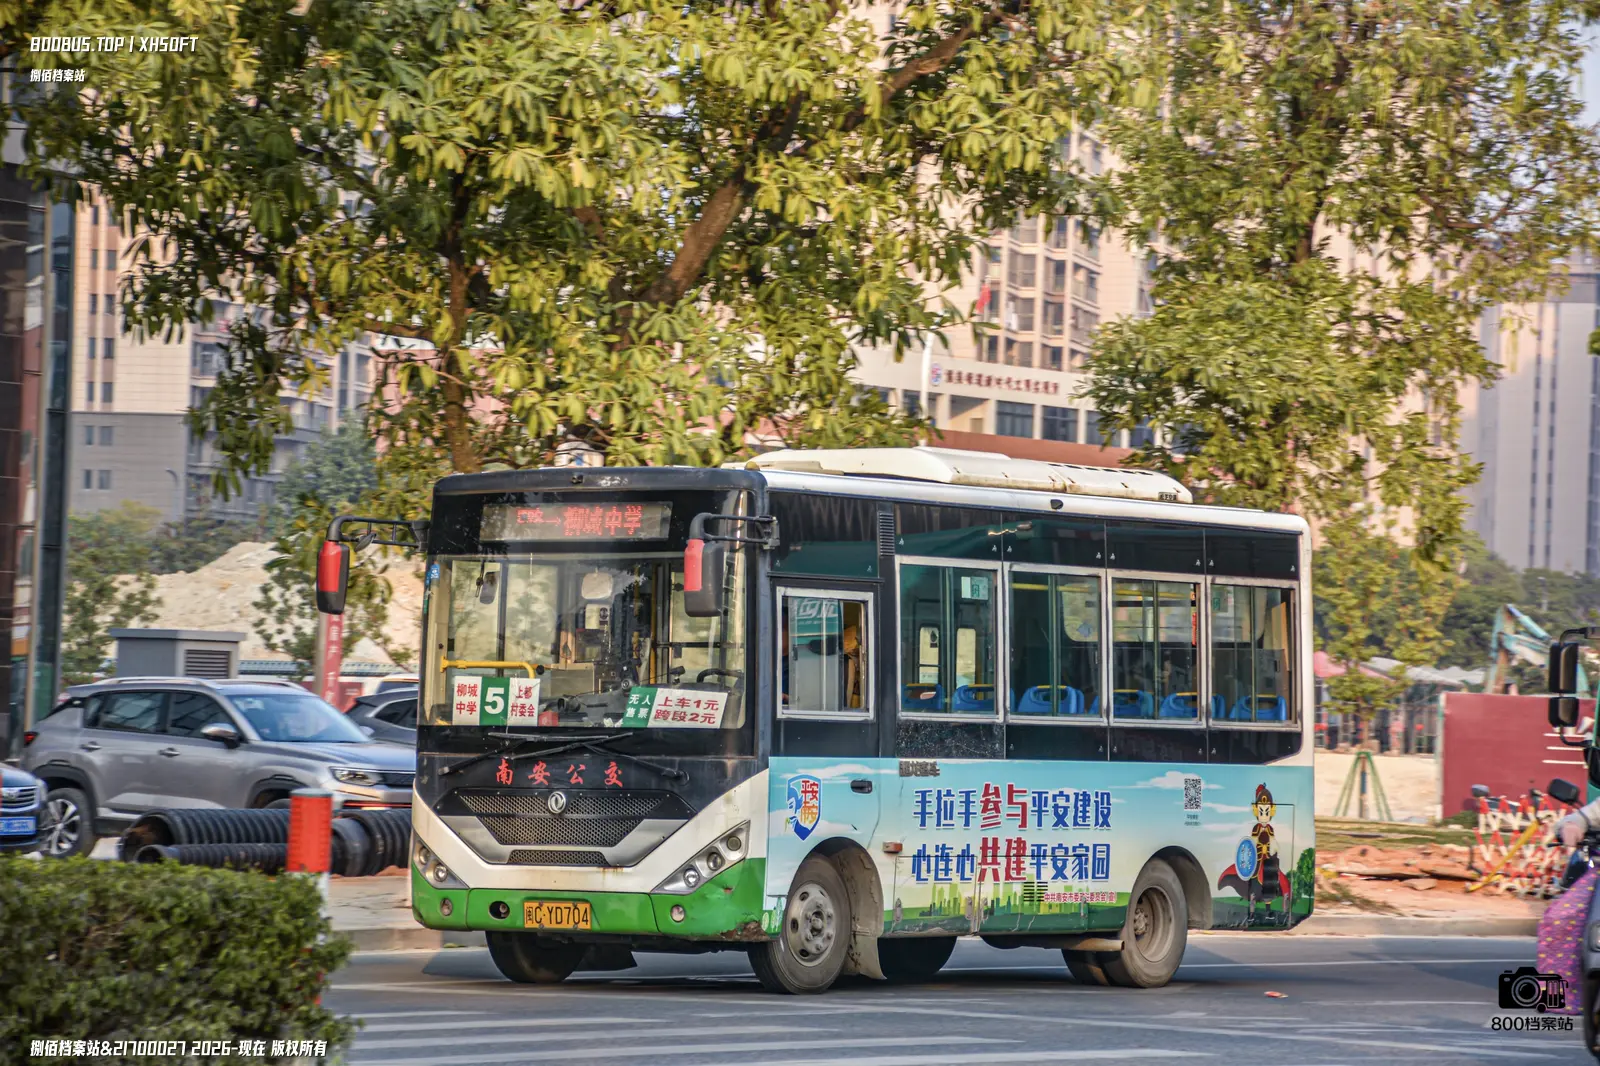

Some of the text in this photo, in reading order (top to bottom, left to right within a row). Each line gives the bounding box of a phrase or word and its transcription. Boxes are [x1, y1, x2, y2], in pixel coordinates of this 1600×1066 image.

[563, 505, 642, 535] 柳城中学
[456, 683, 478, 697] 柳城
[484, 687, 505, 714] 5
[628, 694, 651, 705] 无人
[657, 696, 719, 711] 上车1元
[455, 701, 477, 715] 中学
[510, 703, 535, 717] 村委会
[653, 709, 716, 724] 跨段2元
[495, 758, 623, 787] 南安公交
[912, 782, 1112, 829] 手拉手参与平安建设
[911, 837, 1110, 882] 心连心共建平安家园
